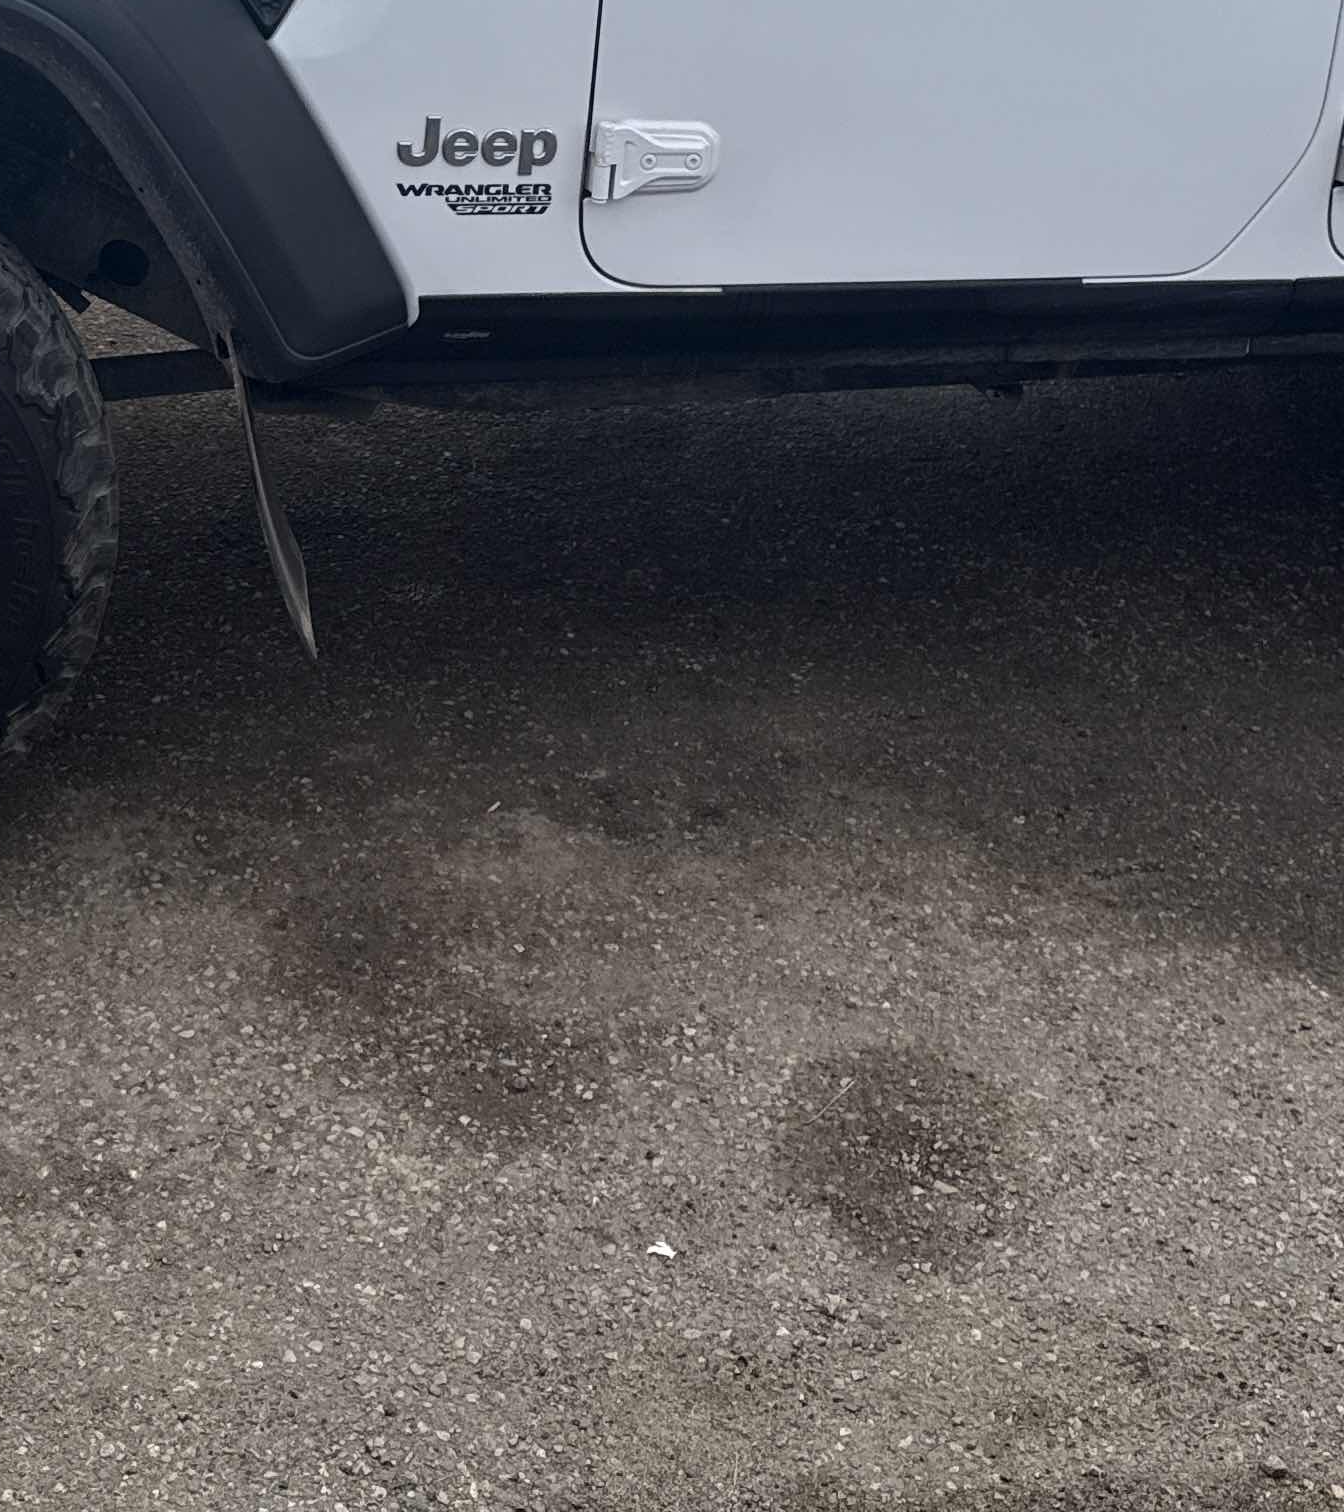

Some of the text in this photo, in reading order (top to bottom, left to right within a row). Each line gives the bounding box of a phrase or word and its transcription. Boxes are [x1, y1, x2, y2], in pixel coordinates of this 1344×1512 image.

[396, 114, 558, 176] Jeep
[396, 183, 552, 196] WRANGLER
[455, 204, 548, 214] SPORT
